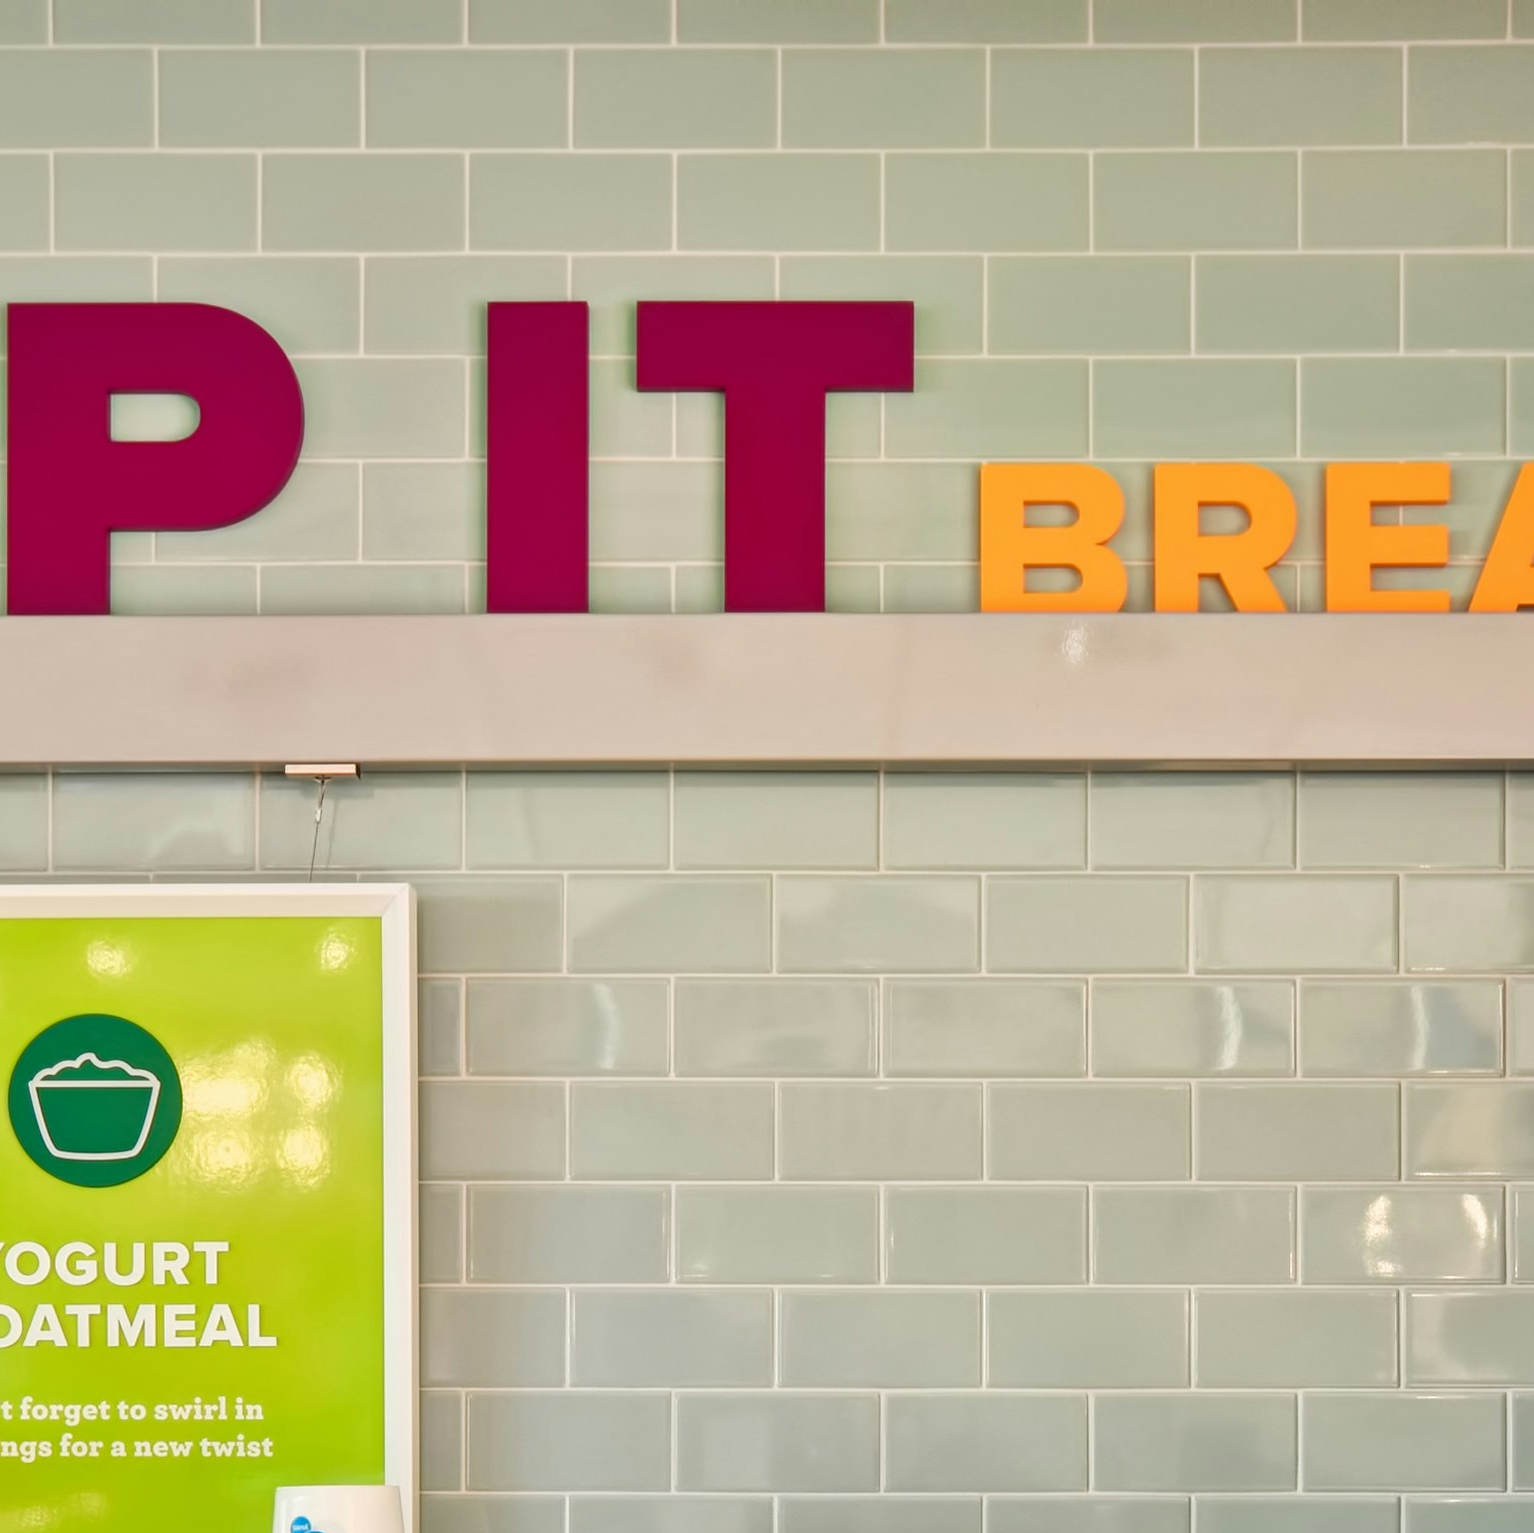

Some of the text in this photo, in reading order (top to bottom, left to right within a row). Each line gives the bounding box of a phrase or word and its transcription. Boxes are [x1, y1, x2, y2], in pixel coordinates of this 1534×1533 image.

[486, 300, 914, 615] IT
[20, 1396, 110, 1426] forget
[117, 1400, 146, 1421] to
[154, 1396, 227, 1421] swirl
[235, 1397, 263, 1421] in
[60, 1434, 103, 1457] for
[111, 1439, 127, 1457] a
[134, 1439, 193, 1457] new
[199, 1434, 273, 1457] twist
